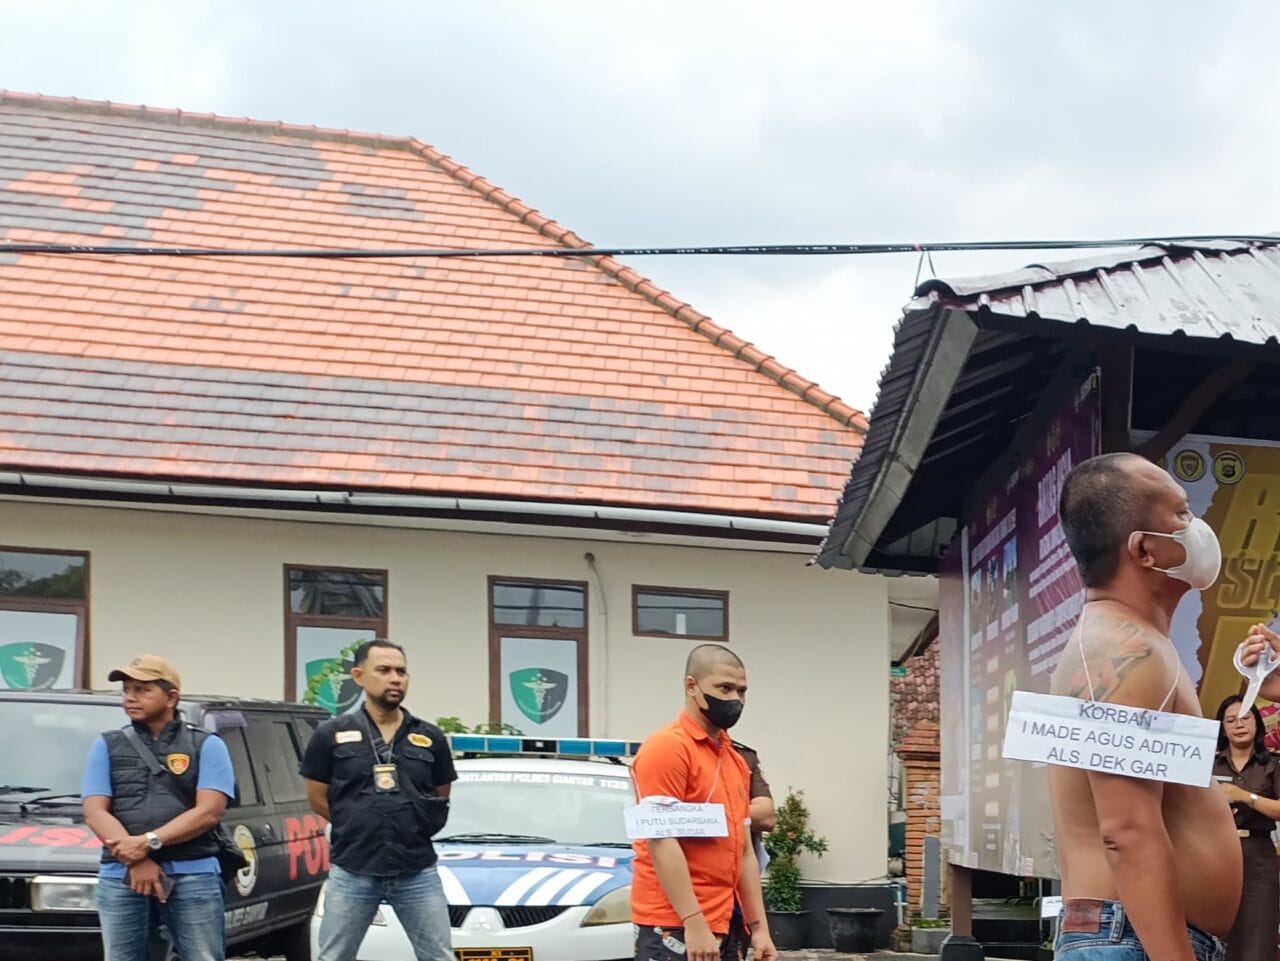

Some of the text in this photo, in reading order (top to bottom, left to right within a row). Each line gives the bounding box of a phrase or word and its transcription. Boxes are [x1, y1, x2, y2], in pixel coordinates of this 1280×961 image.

[1079, 703, 1153, 729] KORBAN
[1021, 720, 1202, 760] I MADE AGUS ADITYA
[1046, 747, 1168, 778] ALS. DEK GAR
[437, 849, 617, 868] OLISI
